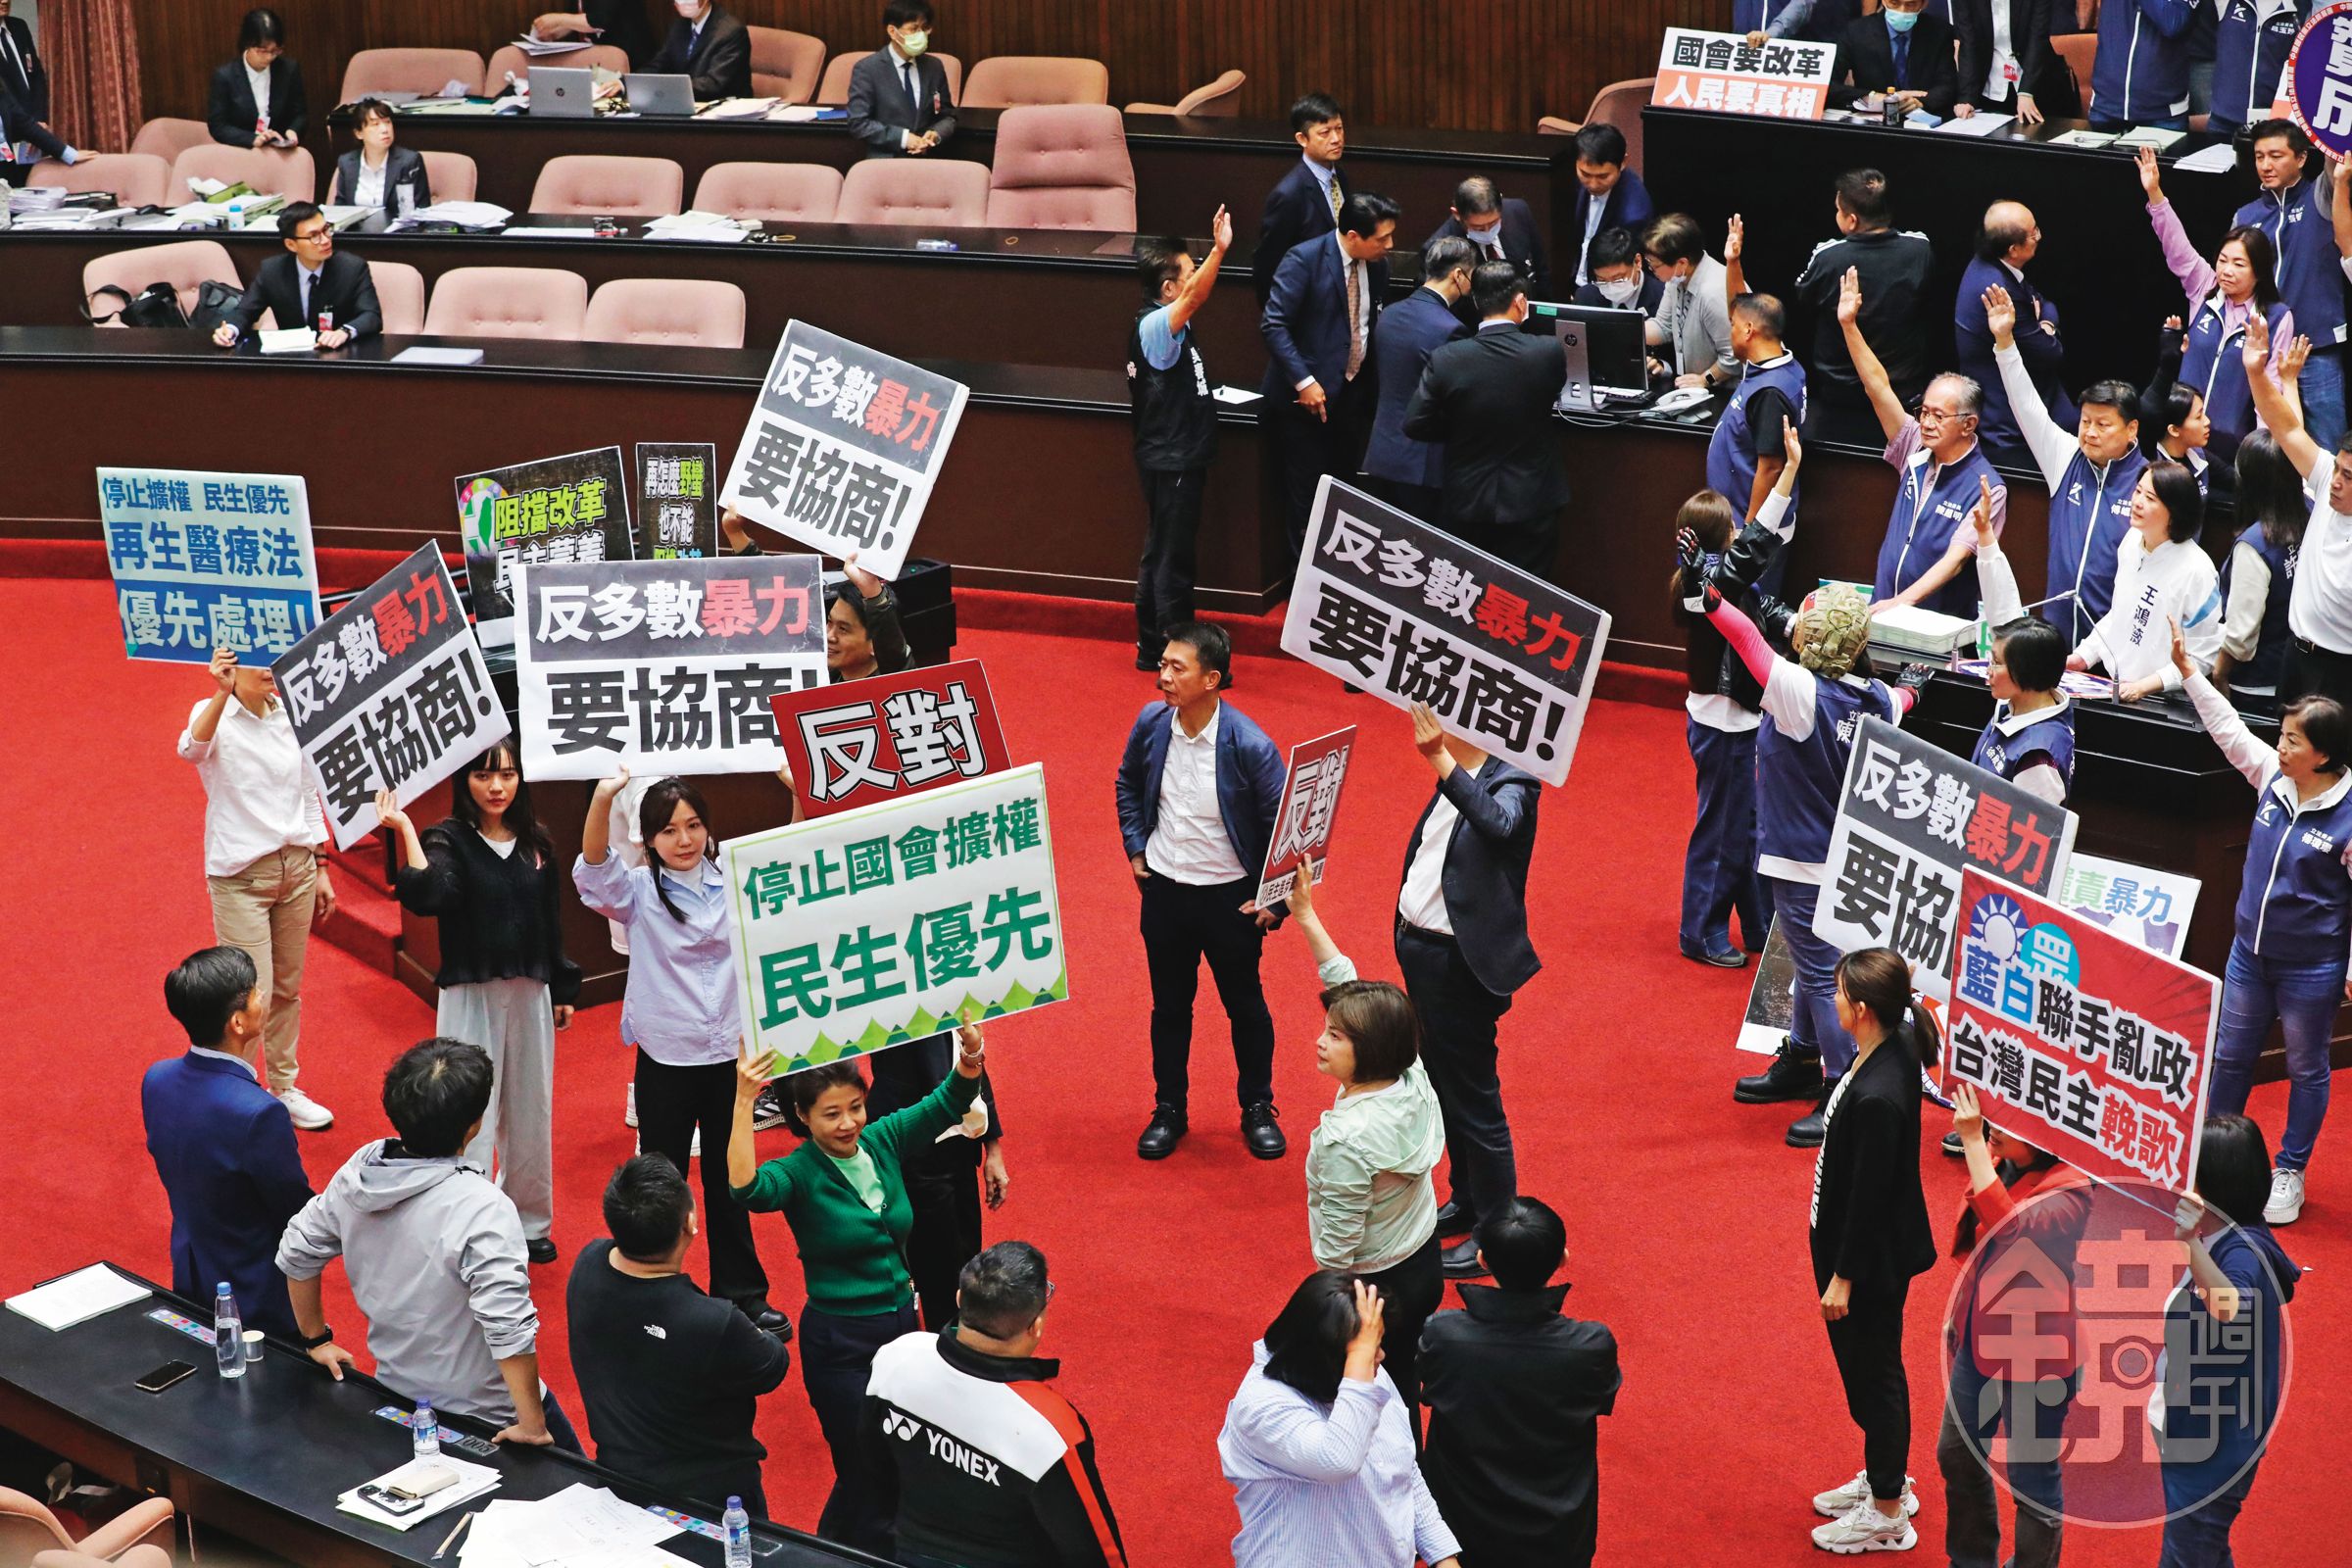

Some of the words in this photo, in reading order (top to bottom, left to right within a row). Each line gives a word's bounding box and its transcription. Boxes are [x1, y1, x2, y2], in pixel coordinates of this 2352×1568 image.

[1665, 75, 1818, 119] 人民要真相
[1672, 35, 1825, 78] 國會要改革
[771, 342, 941, 454] 反多數暴力
[102, 477, 192, 513] 停止擴權
[203, 482, 290, 514] 民生優先
[494, 477, 607, 541] 阻擋改革
[658, 502, 695, 545] 也不能
[739, 419, 912, 552] 要協商!
[109, 521, 304, 579] 再生醫療法
[535, 576, 809, 644] 反多數暴力
[1322, 510, 1584, 672] 反多數暴力
[280, 571, 449, 727] 反多數暴力
[546, 662, 818, 756] 要協商
[1308, 582, 1566, 761] 要協商!
[313, 648, 492, 827] 要協商!
[795, 682, 988, 804] 反對
[743, 797, 1043, 920] 停止國會擴權
[1272, 745, 1349, 865] 反對
[1854, 738, 2053, 886] 反多數暴力
[759, 887, 1054, 1031] 民生優先
[1834, 830, 1961, 982] 要協
[1961, 943, 2191, 1102] 藍白聯手亂政
[1954, 1022, 2180, 1179] 台灣民主輓歌
[925, 1427, 1001, 1487] YONEX
